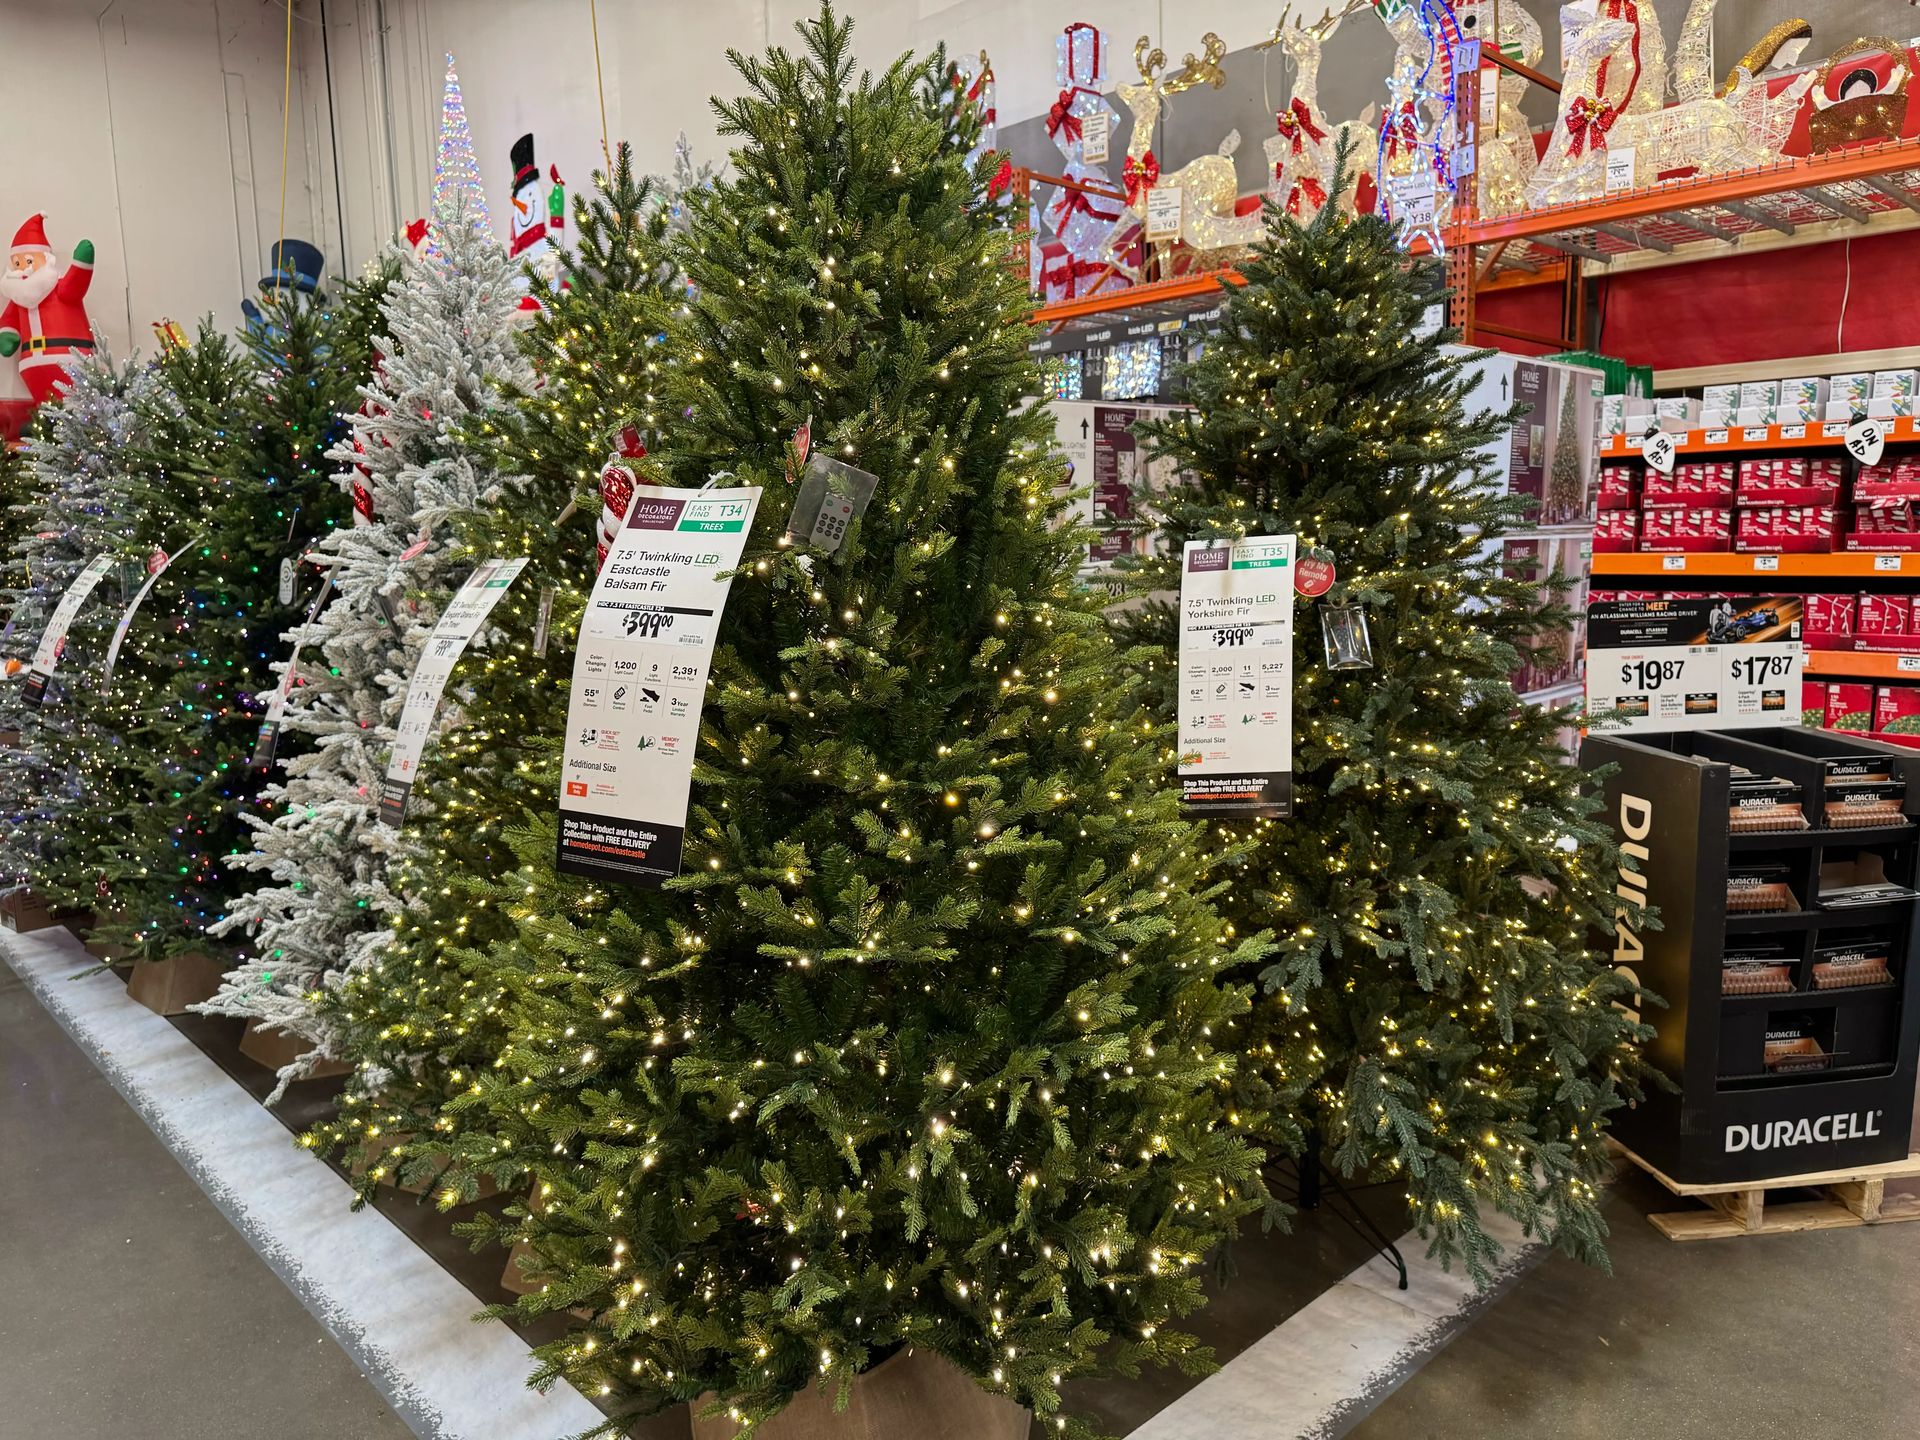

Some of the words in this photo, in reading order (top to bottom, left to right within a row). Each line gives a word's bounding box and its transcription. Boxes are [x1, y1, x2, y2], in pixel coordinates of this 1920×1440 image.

[1411, 212, 1431, 223] Y38
[1522, 370, 1540, 383] HOME
[1104, 413, 1126, 423] HOME
[1862, 427, 1879, 446] ON
[1656, 439, 1671, 454] ON
[1849, 439, 1866, 455] AD
[1648, 451, 1664, 465] AD
[640, 503, 677, 516] HOME
[720, 504, 744, 517] T34
[700, 522, 724, 531] TREES
[616, 550, 637, 560] 7.5'
[639, 551, 693, 565] Twinkling
[694, 554, 720, 565] LED
[1194, 551, 1224, 561] HOME
[1261, 547, 1283, 557] T35
[1511, 546, 1530, 558] HOME
[610, 564, 671, 577] Eastcastle
[1316, 561, 1329, 572] My
[1299, 567, 1328, 581] Remote
[604, 578, 648, 591] Balsam
[650, 580, 668, 592] Fir
[1108, 582, 1122, 598] 28
[625, 603, 654, 611] EASTCASTLE
[1188, 599, 1204, 608] 7.5'
[1206, 595, 1254, 606] Twinkling
[1255, 594, 1276, 603] LED
[1645, 601, 1669, 611] MEET
[1188, 609, 1234, 619] Yorkshire
[1236, 607, 1250, 616] Fir
[614, 661, 637, 670] 1,200
[652, 664, 658, 672] 9
[672, 666, 698, 676] 2,391
[671, 697, 677, 706] 3
[1183, 737, 1213, 745] Additional
[569, 758, 602, 771] Additional
[602, 763, 617, 773] Size
[1832, 766, 1868, 774] DURACELL
[1740, 797, 1777, 806] DURACELL
[1844, 793, 1880, 802] DURACELL
[564, 819, 579, 829] Shop
[579, 821, 592, 831] This
[592, 823, 615, 835] Product
[616, 828, 628, 837] and
[628, 829, 639, 838] the
[639, 831, 658, 842] Entire
[563, 829, 591, 841] Collection
[591, 833, 605, 843] with
[605, 835, 621, 846] FREE
[569, 840, 646, 859] homedepot.com/eastcastle
[1830, 953, 1865, 963] DURACELL
[1765, 1030, 1801, 1039] DURACELL
[1725, 1110, 1881, 1153] DURACELL
